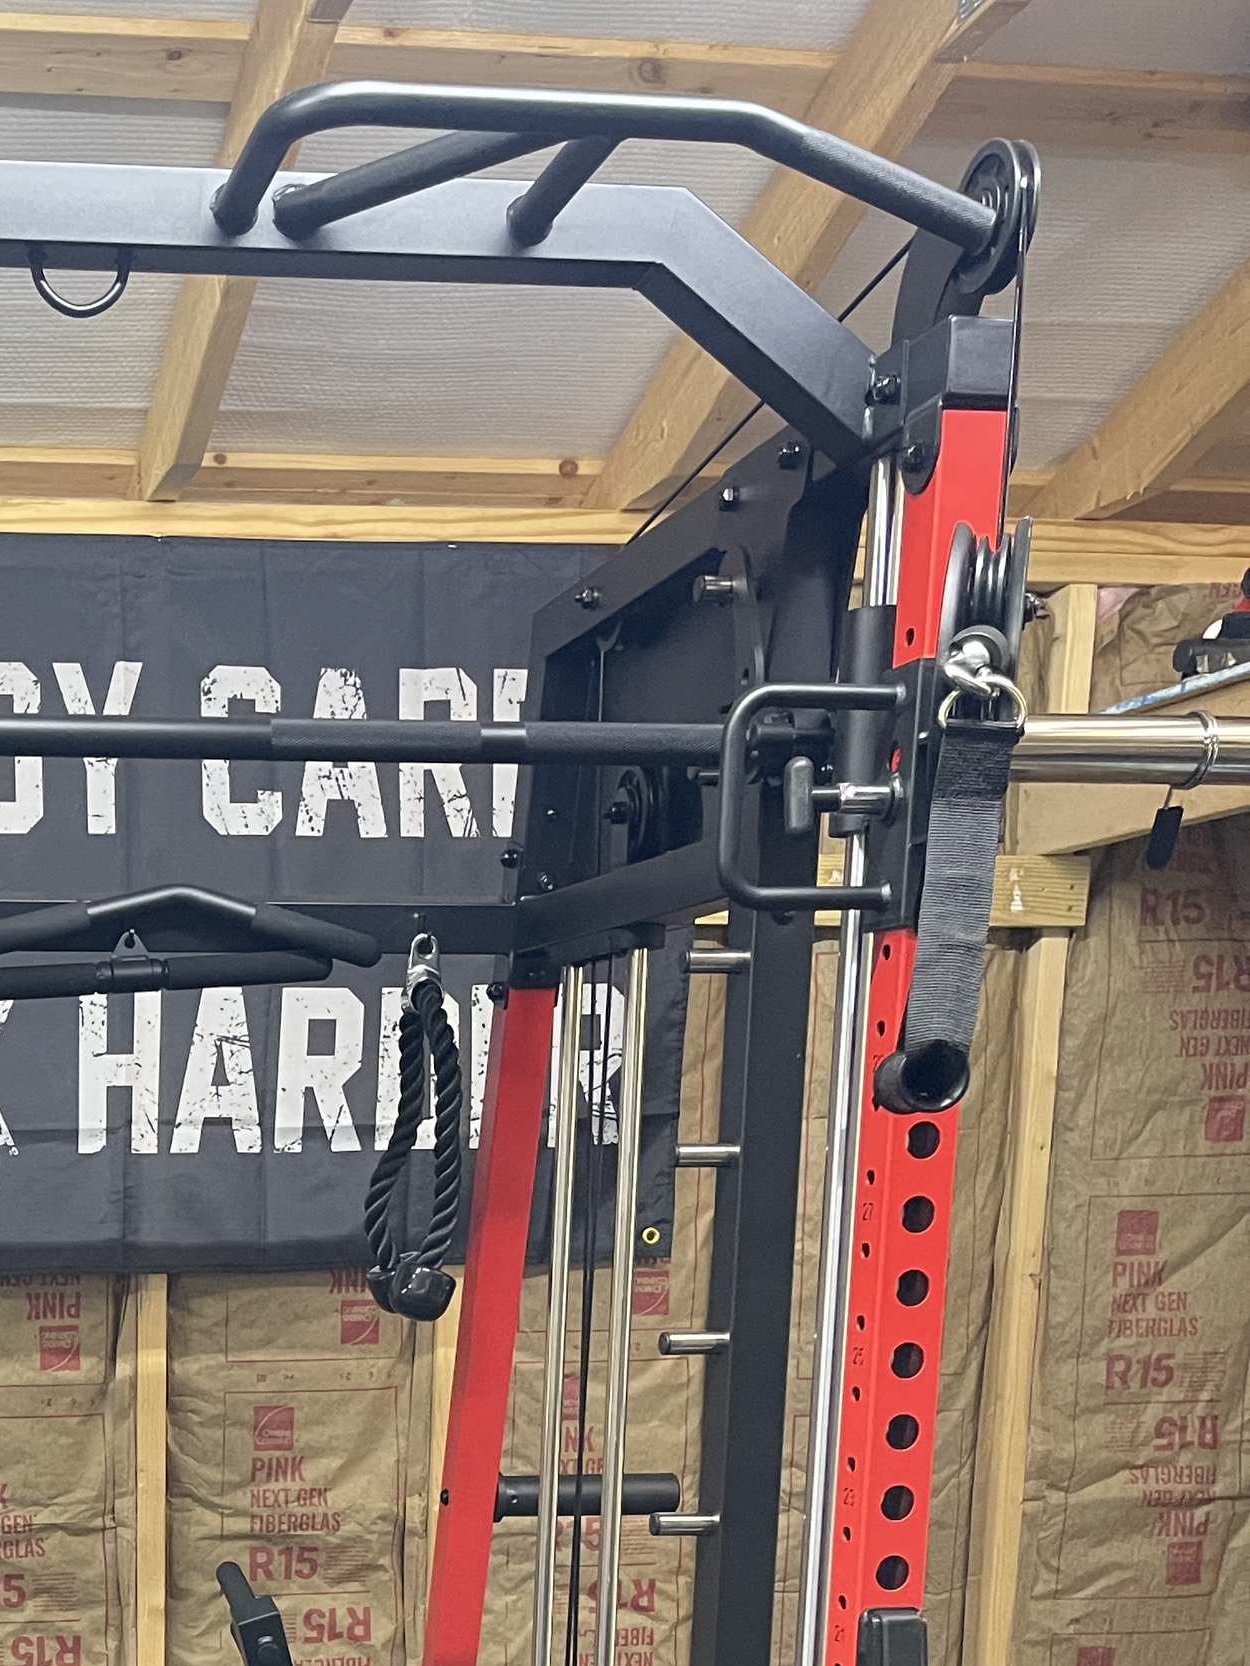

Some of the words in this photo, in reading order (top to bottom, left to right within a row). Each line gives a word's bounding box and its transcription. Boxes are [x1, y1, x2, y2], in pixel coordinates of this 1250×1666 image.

[1176, 1036, 1208, 1058] GEN
[1202, 1062, 1249, 1091] PINK
[1112, 1260, 1163, 1288] PINK
[26, 1292, 81, 1320] PINK
[1111, 1293, 1148, 1313] NEXT
[1155, 1291, 1188, 1312] GEN
[1108, 1317, 1198, 1339] FIBERGLAS
[1105, 1352, 1175, 1390] R15
[1154, 1415, 1219, 1451] R15
[251, 1456, 305, 1483] PINK
[250, 1489, 293, 1508] NEXT
[297, 1487, 329, 1507] GEN
[1, 1514, 33, 1533] GEN
[251, 1512, 341, 1534] FIBERGLAS
[1158, 1511, 1209, 1537] PINK
[250, 1546, 319, 1582] R15
[302, 1607, 372, 1645] R15
